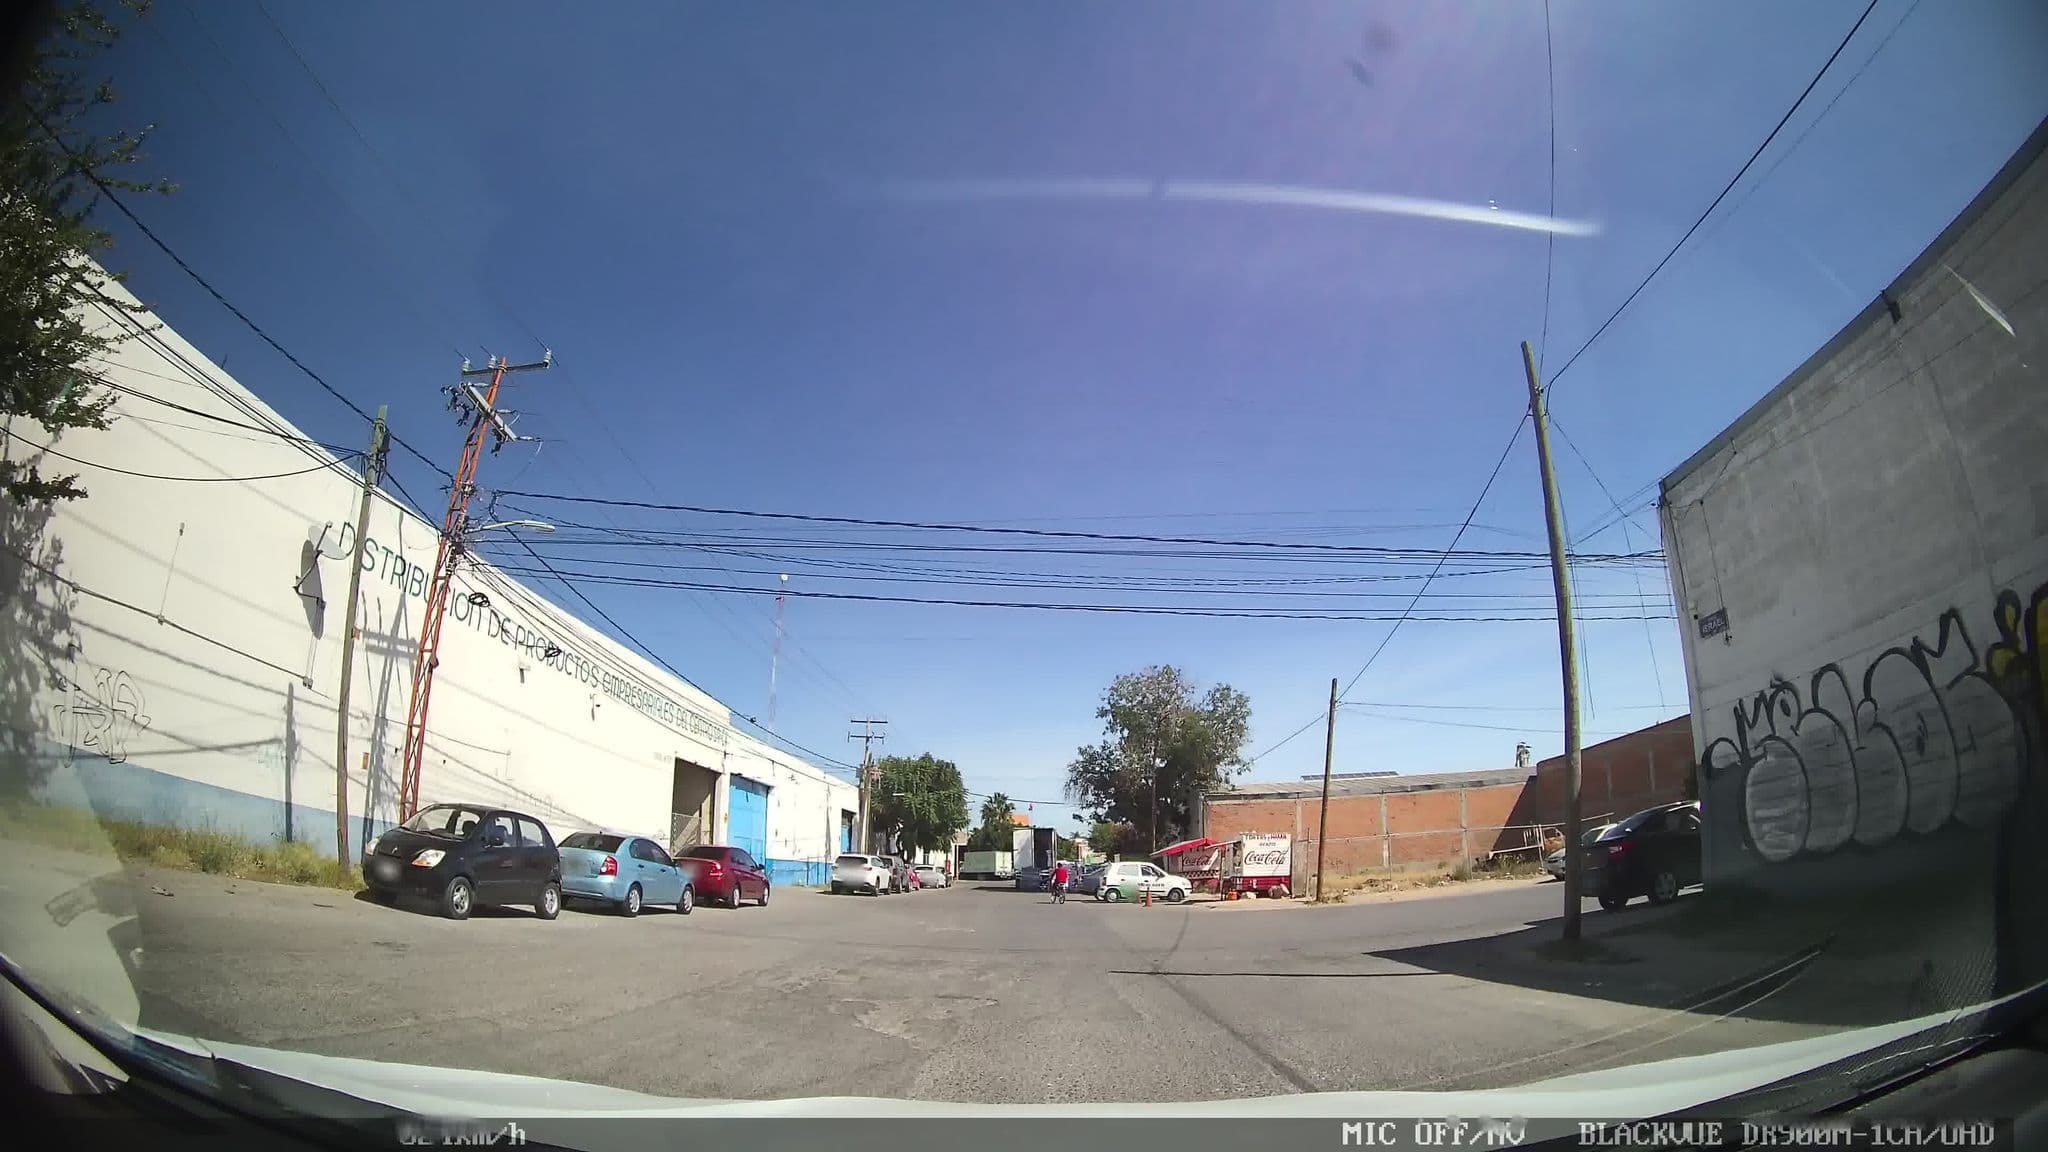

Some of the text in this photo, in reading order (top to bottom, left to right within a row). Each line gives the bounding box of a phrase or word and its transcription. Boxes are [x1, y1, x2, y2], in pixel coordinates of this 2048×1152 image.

[338, 522, 482, 632] DSTRIBUION
[488, 609, 511, 646] DE
[515, 625, 600, 688] PRODUCTOS
